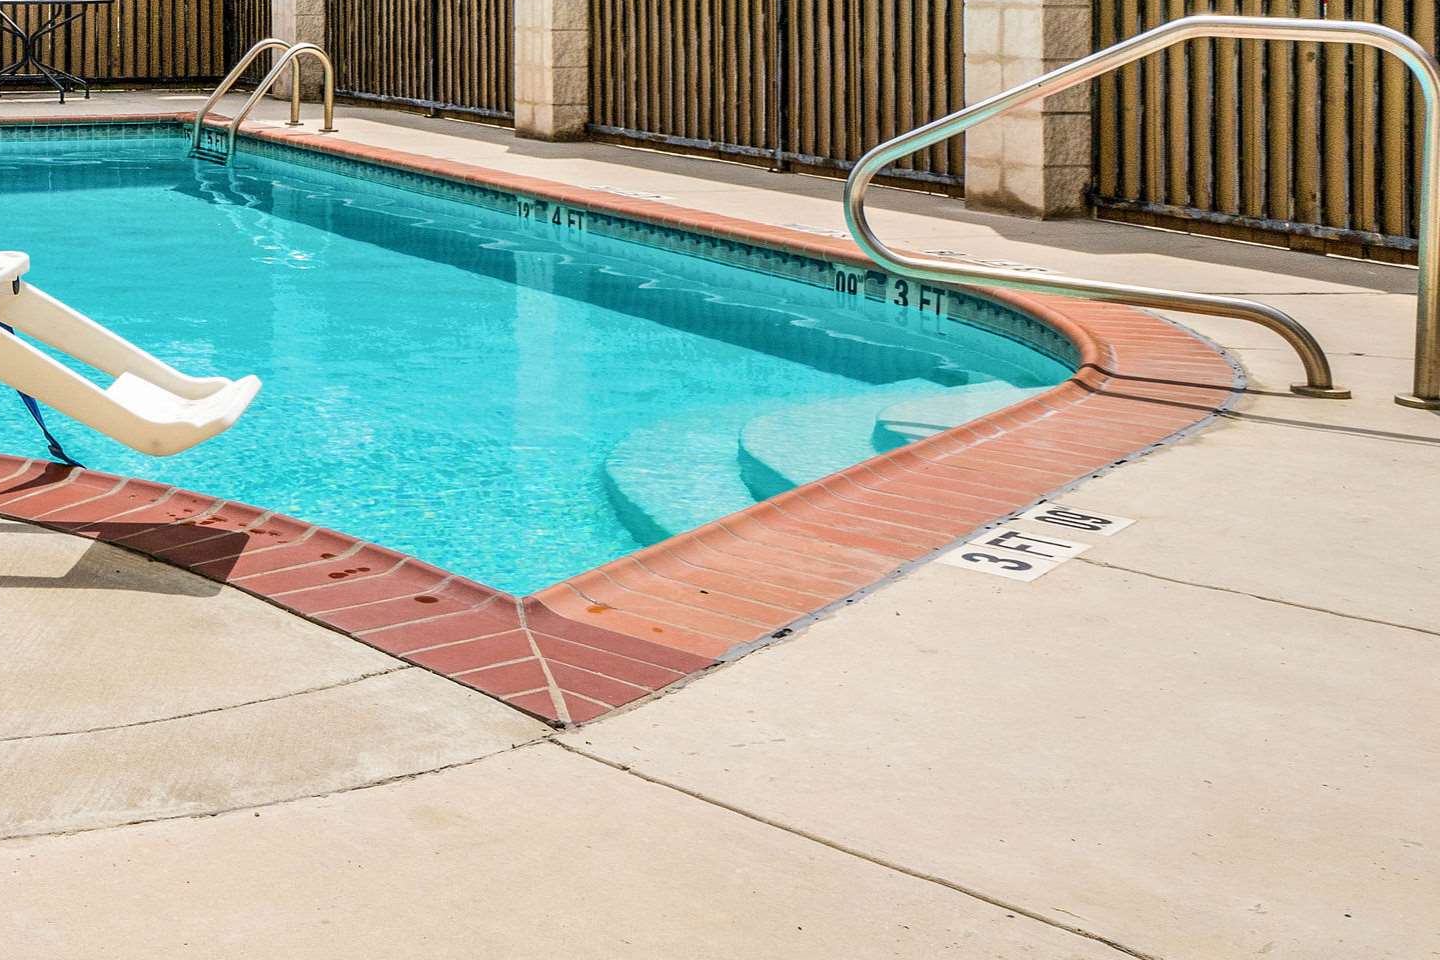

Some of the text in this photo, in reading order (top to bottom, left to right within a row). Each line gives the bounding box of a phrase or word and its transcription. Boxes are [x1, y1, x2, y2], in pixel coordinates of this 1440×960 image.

[567, 209, 585, 231] FT
[893, 279, 909, 307] 3
[919, 284, 946, 316] FT
[985, 531, 1073, 558] FT
[961, 552, 1033, 571] 3
